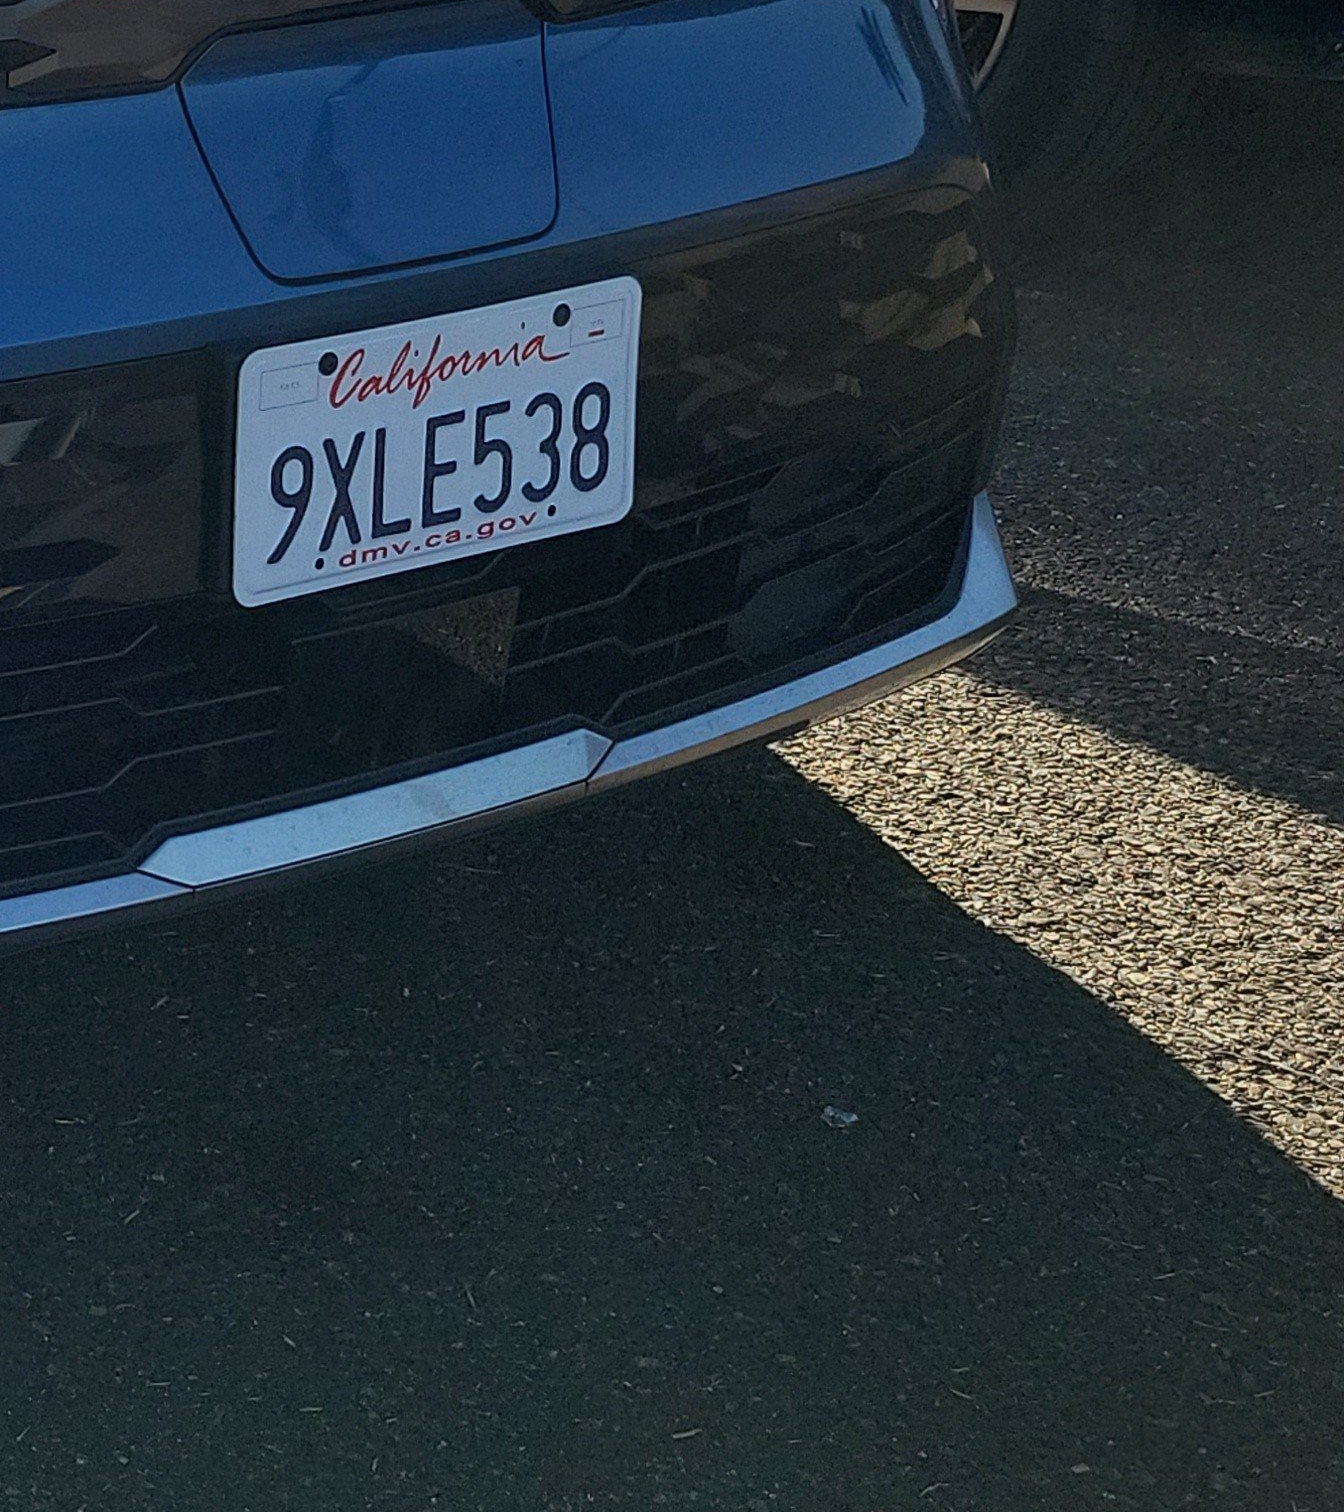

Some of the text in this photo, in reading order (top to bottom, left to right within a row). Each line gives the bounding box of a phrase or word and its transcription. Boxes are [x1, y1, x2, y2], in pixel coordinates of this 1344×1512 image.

[328, 322, 570, 409] California
[266, 381, 612, 565] 9XLE538
[338, 510, 539, 569] dmv.ca.gov
